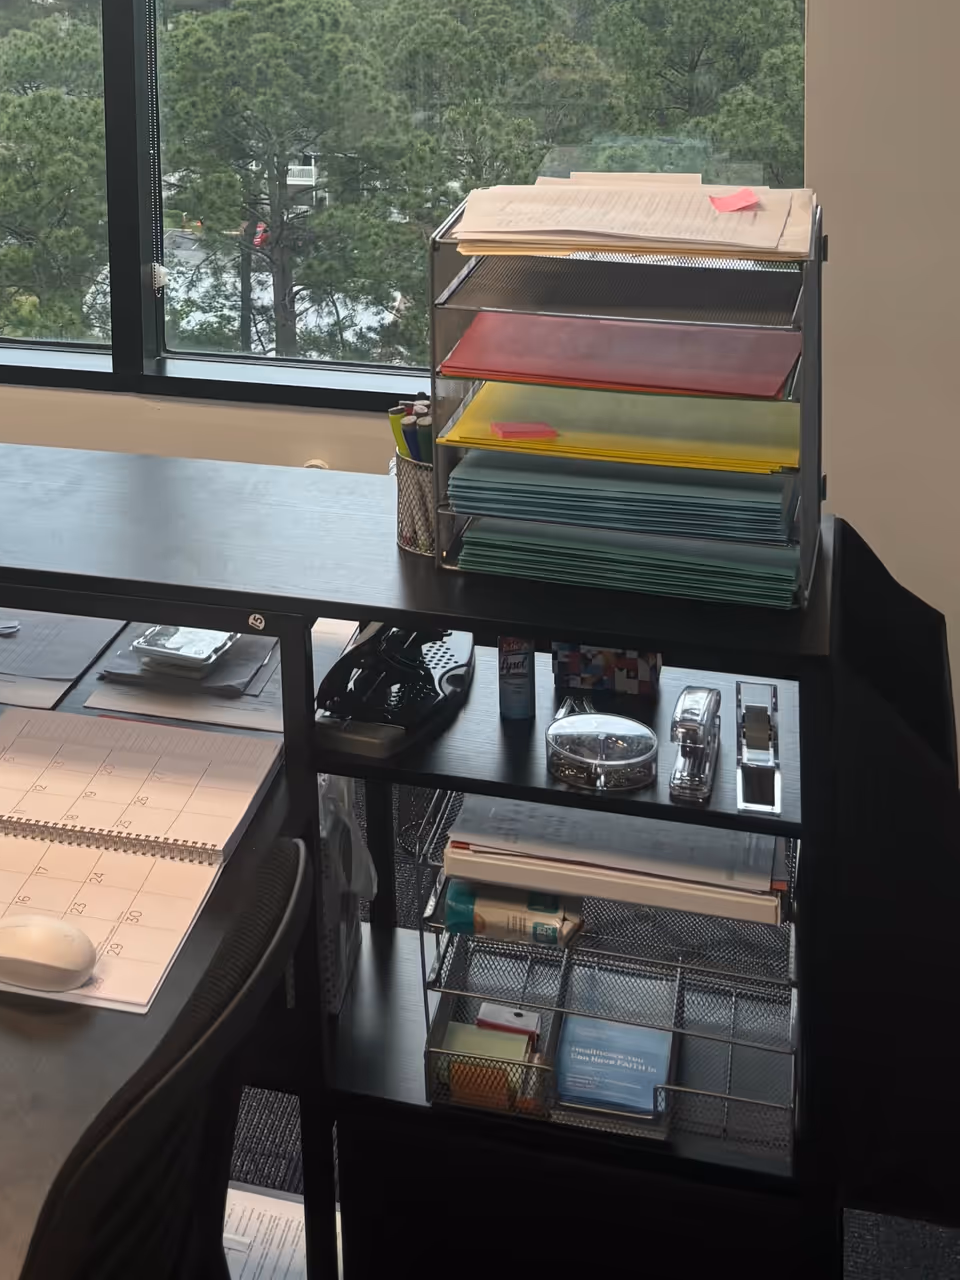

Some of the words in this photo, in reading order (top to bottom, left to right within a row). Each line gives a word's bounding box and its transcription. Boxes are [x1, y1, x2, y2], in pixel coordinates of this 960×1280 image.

[250, 614, 263, 629] 15
[500, 655, 528, 675] Lysol
[31, 784, 48, 794] 12
[82, 790, 98, 800] 19
[35, 865, 50, 877] 17
[89, 871, 106, 885] 24
[15, 894, 32, 906] 16
[70, 901, 88, 916] 23
[125, 909, 144, 924] 30
[106, 942, 125, 957] 29
